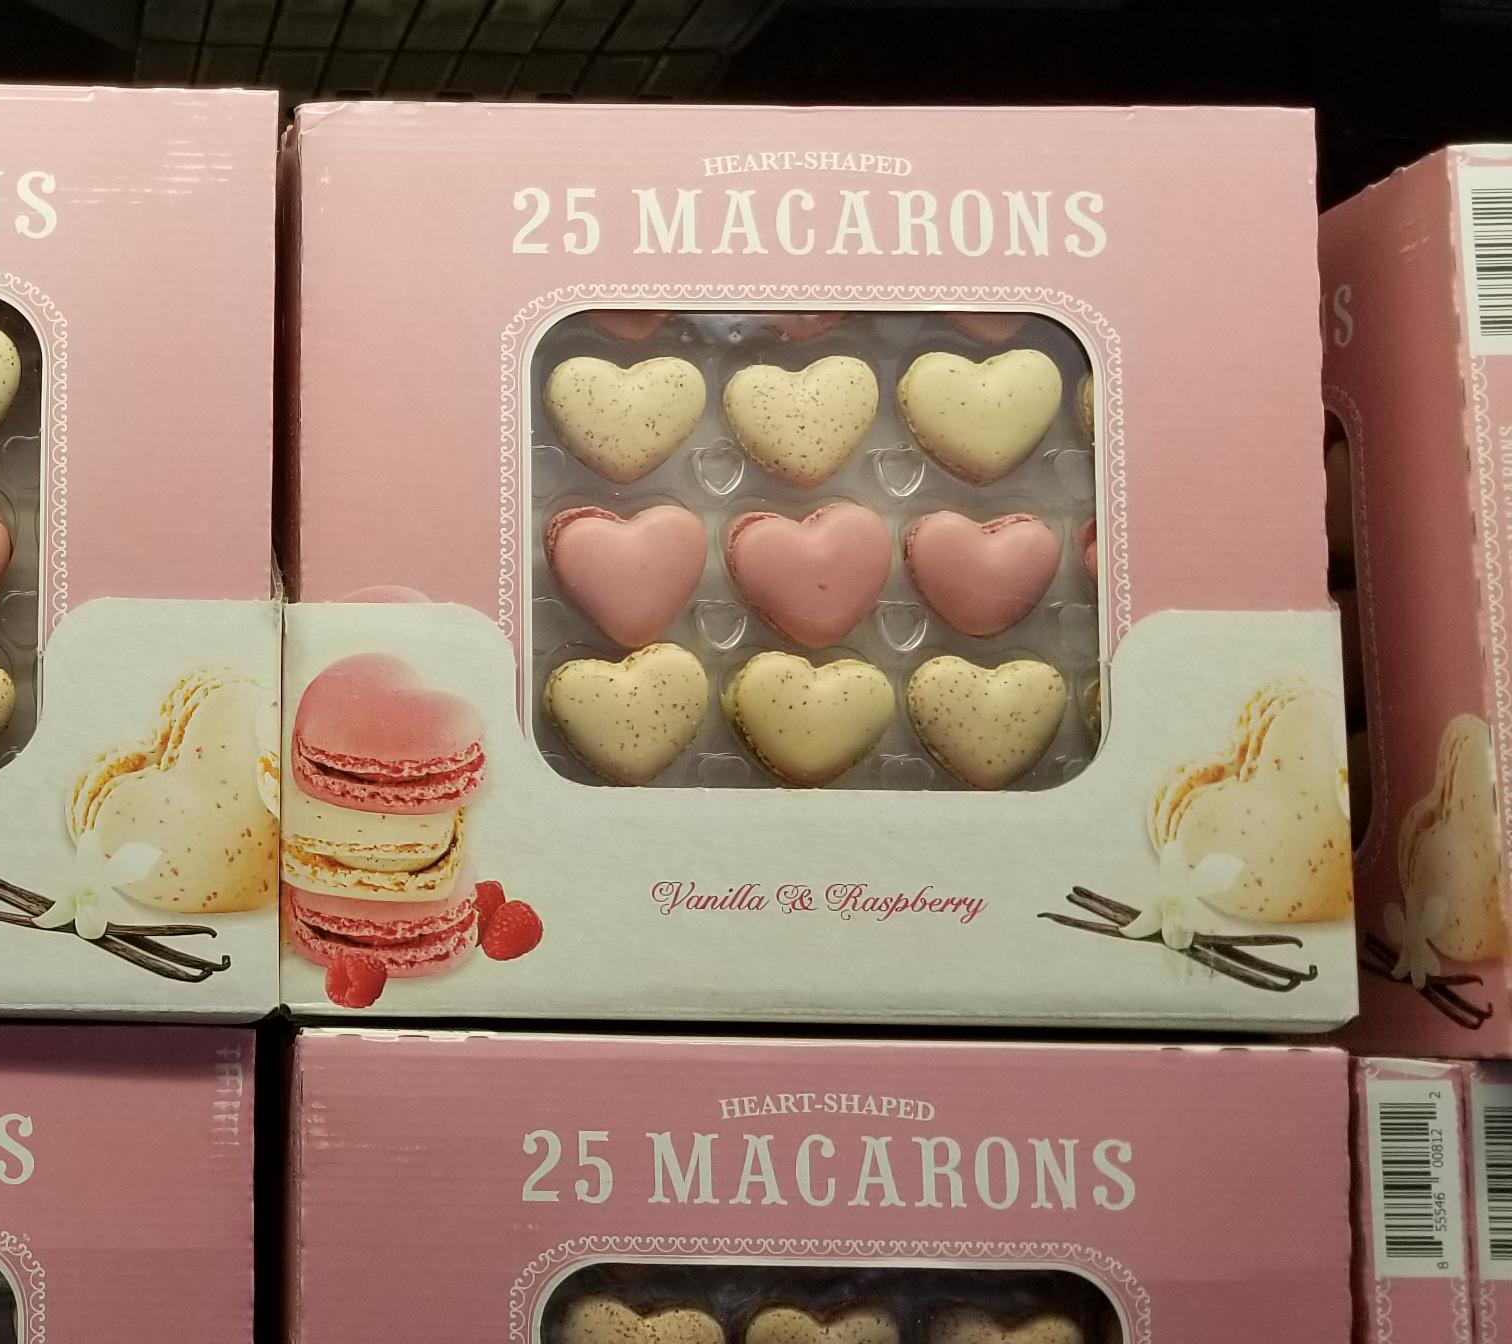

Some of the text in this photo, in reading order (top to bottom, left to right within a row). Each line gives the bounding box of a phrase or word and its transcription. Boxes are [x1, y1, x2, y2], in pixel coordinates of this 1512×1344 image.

[701, 151, 913, 178] HEART-SHAPED
[512, 187, 1108, 258] 25 MACARONS
[651, 881, 987, 924] Vanilla & Raspberry
[718, 1093, 936, 1123] HEART-SHAPED
[1430, 1128, 1445, 1169] 00812
[521, 1129, 1136, 1212] 25 MACARONS
[1433, 1192, 1447, 1233] 55546
